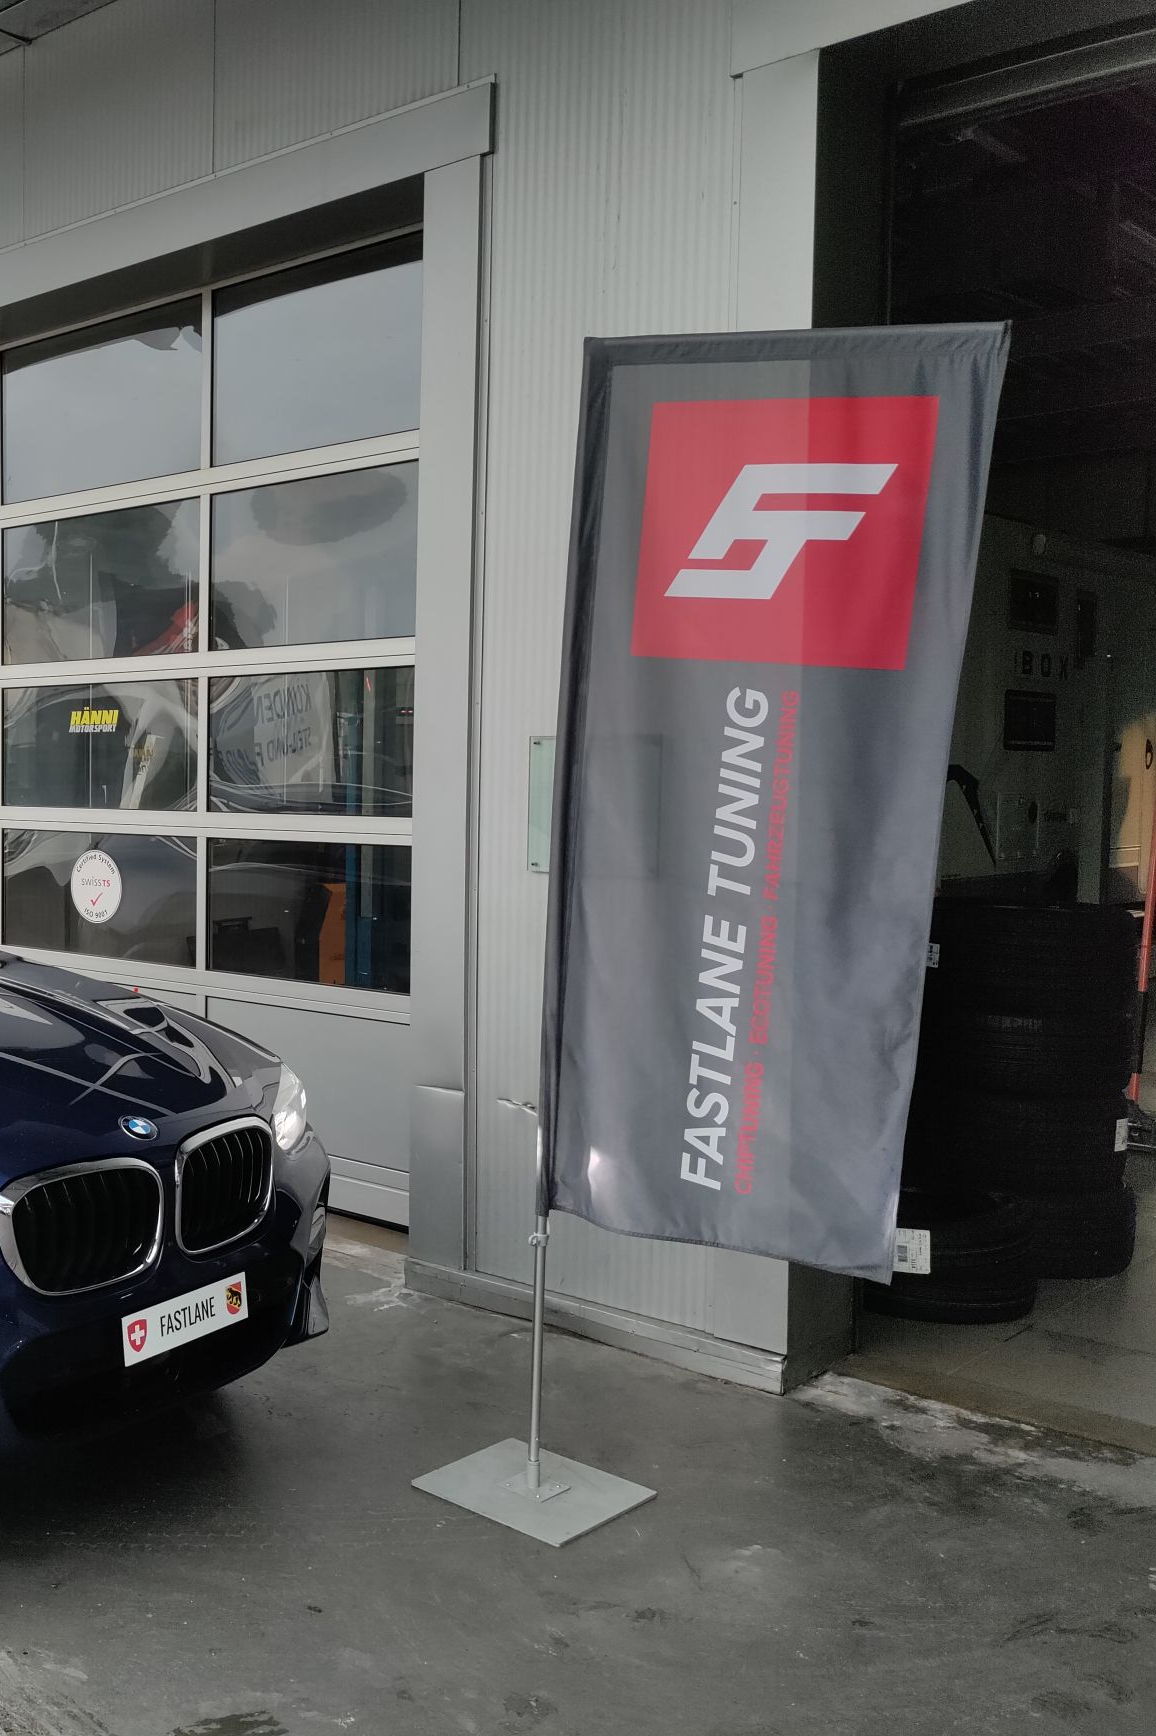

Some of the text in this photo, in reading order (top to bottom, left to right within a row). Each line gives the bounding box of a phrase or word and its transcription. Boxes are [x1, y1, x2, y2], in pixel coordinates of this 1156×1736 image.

[70, 706, 119, 725] HÄNNI
[68, 723, 117, 733] MOTORSPORT
[98, 854, 116, 875] System
[84, 907, 94, 918] ISO
[680, 686, 769, 1191] FASTLANE TUNING
[734, 690, 800, 1196] CHIPTUNING ECOTUNING FAHRZEUGTUNING
[160, 1296, 216, 1337] FASTLANE
